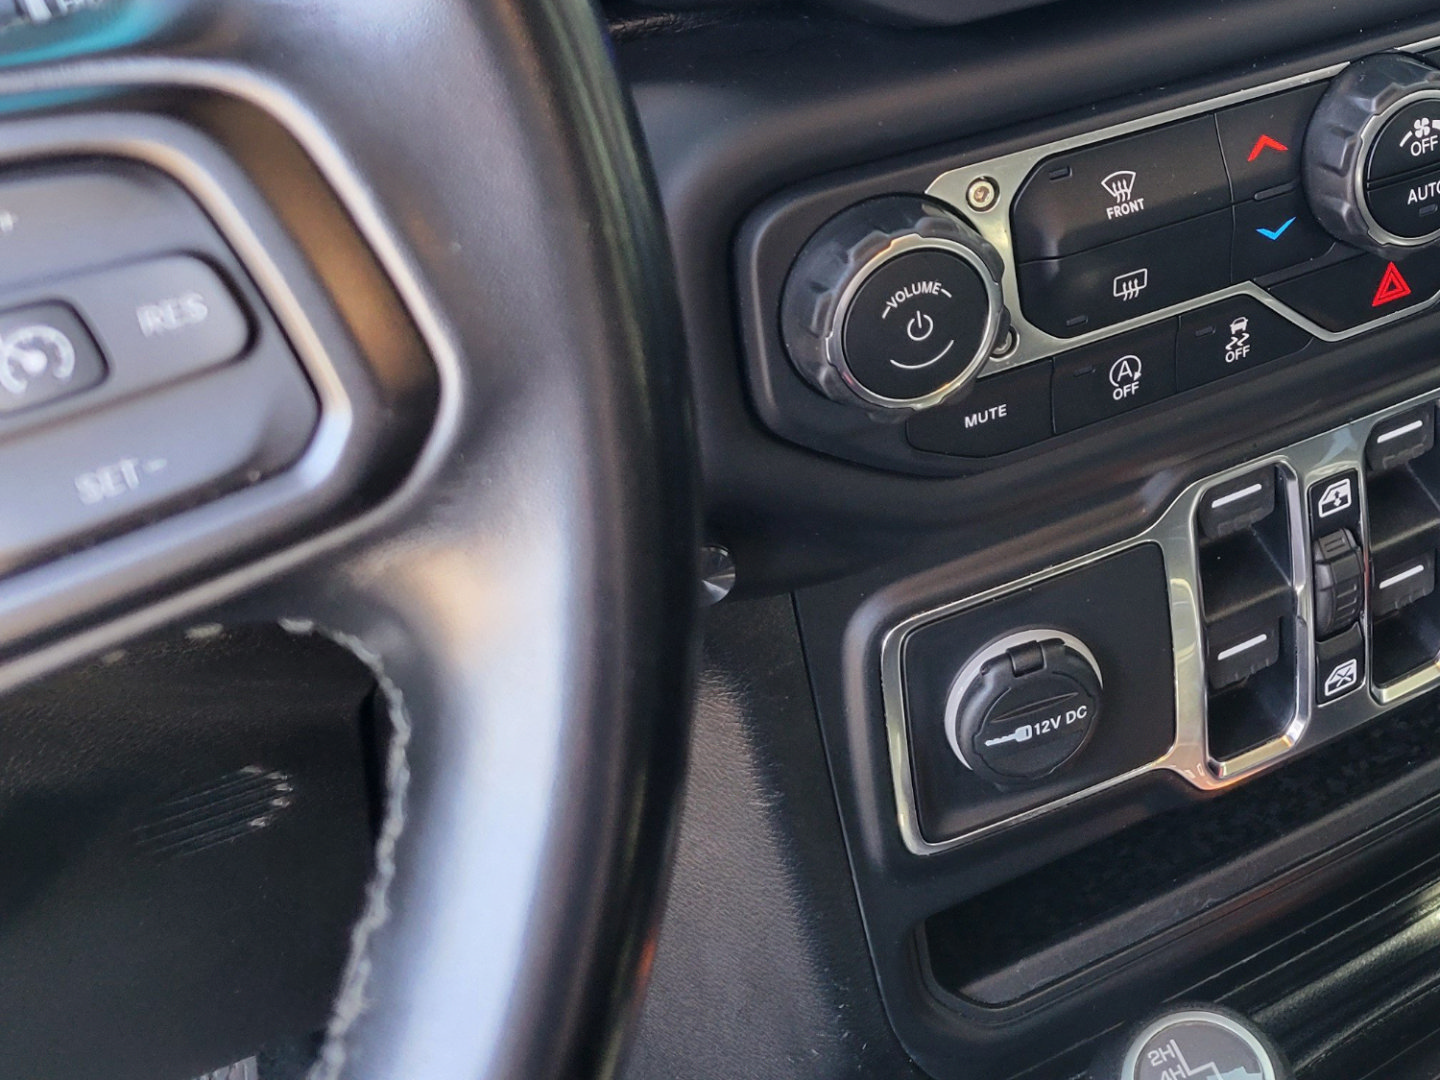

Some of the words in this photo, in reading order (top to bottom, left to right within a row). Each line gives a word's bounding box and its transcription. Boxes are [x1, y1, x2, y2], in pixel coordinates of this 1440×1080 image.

[1410, 136, 1439, 157] OFF
[1106, 197, 1145, 220] FRONT
[887, 280, 942, 309] VOLUME
[1225, 343, 1250, 363] OFF
[1113, 380, 1140, 401] OFF
[964, 404, 1008, 429] MUTE
[1034, 715, 1062, 736] 12V
[1066, 705, 1088, 724] DC
[1148, 1043, 1176, 1067] 2H
